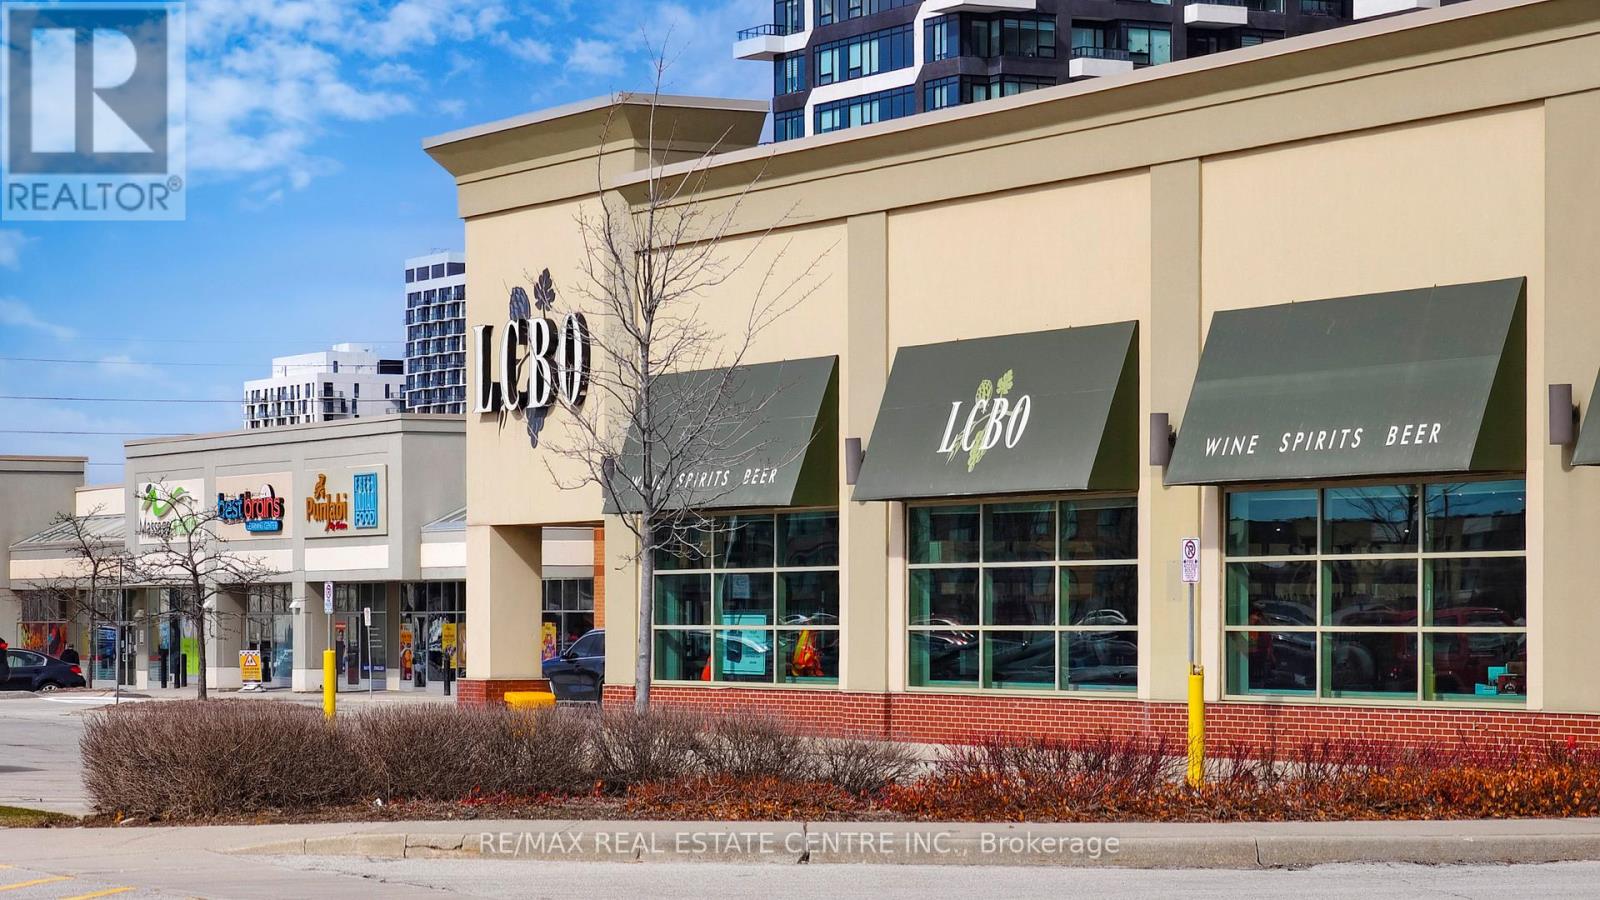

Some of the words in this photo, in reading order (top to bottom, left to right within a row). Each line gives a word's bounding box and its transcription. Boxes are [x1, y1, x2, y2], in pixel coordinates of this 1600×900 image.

[474, 312, 591, 413] LCBO
[936, 395, 1031, 453] LCBO
[1205, 434, 1259, 456] WINE
[1279, 428, 1363, 452] SPIRITS
[1385, 423, 1441, 446] BEER
[676, 470, 731, 488] SPIRITS
[742, 468, 778, 485] BEER
[217, 492, 244, 519] best
[244, 491, 285, 519] brains
[306, 493, 348, 526] Punjabi
